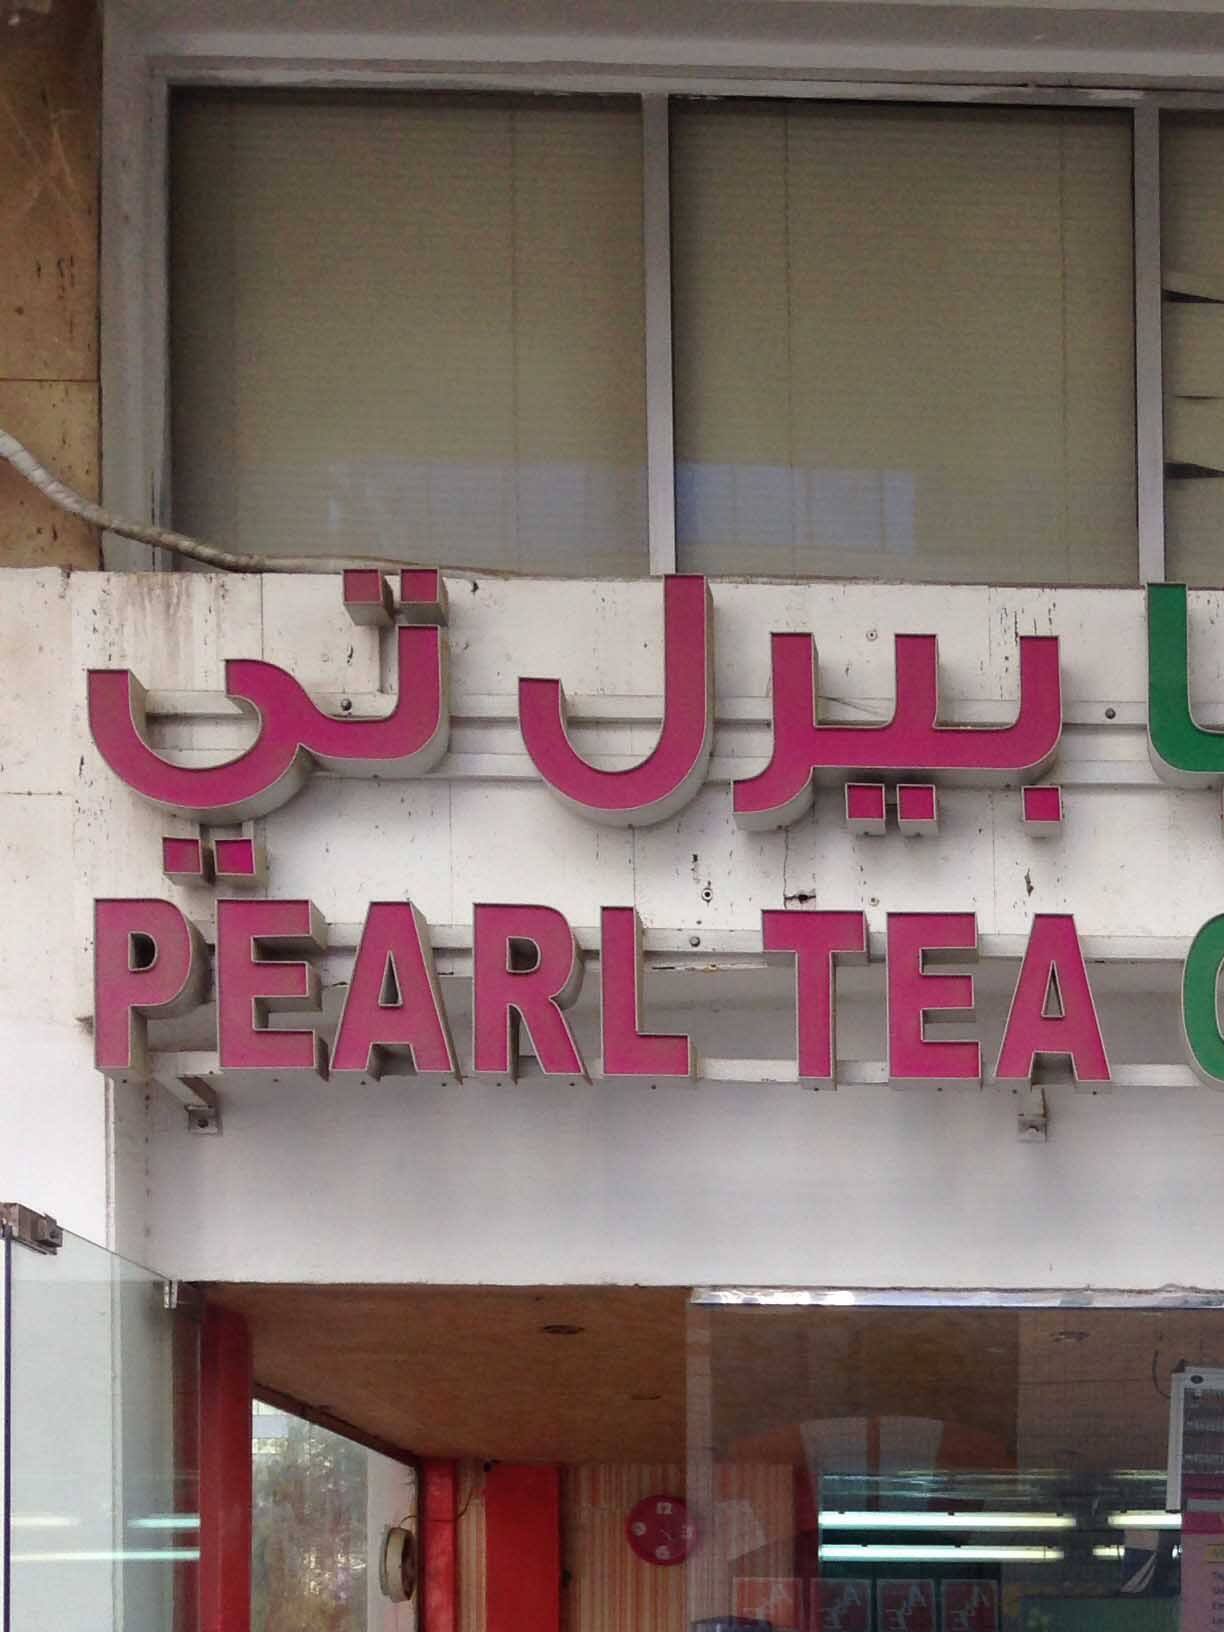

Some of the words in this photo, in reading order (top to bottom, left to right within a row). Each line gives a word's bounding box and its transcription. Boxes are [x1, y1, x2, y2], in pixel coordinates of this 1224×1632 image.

[517, 573, 1064, 833] بيرل
[93, 897, 697, 1082] PEARL
[760, 908, 1112, 1088] TEA
